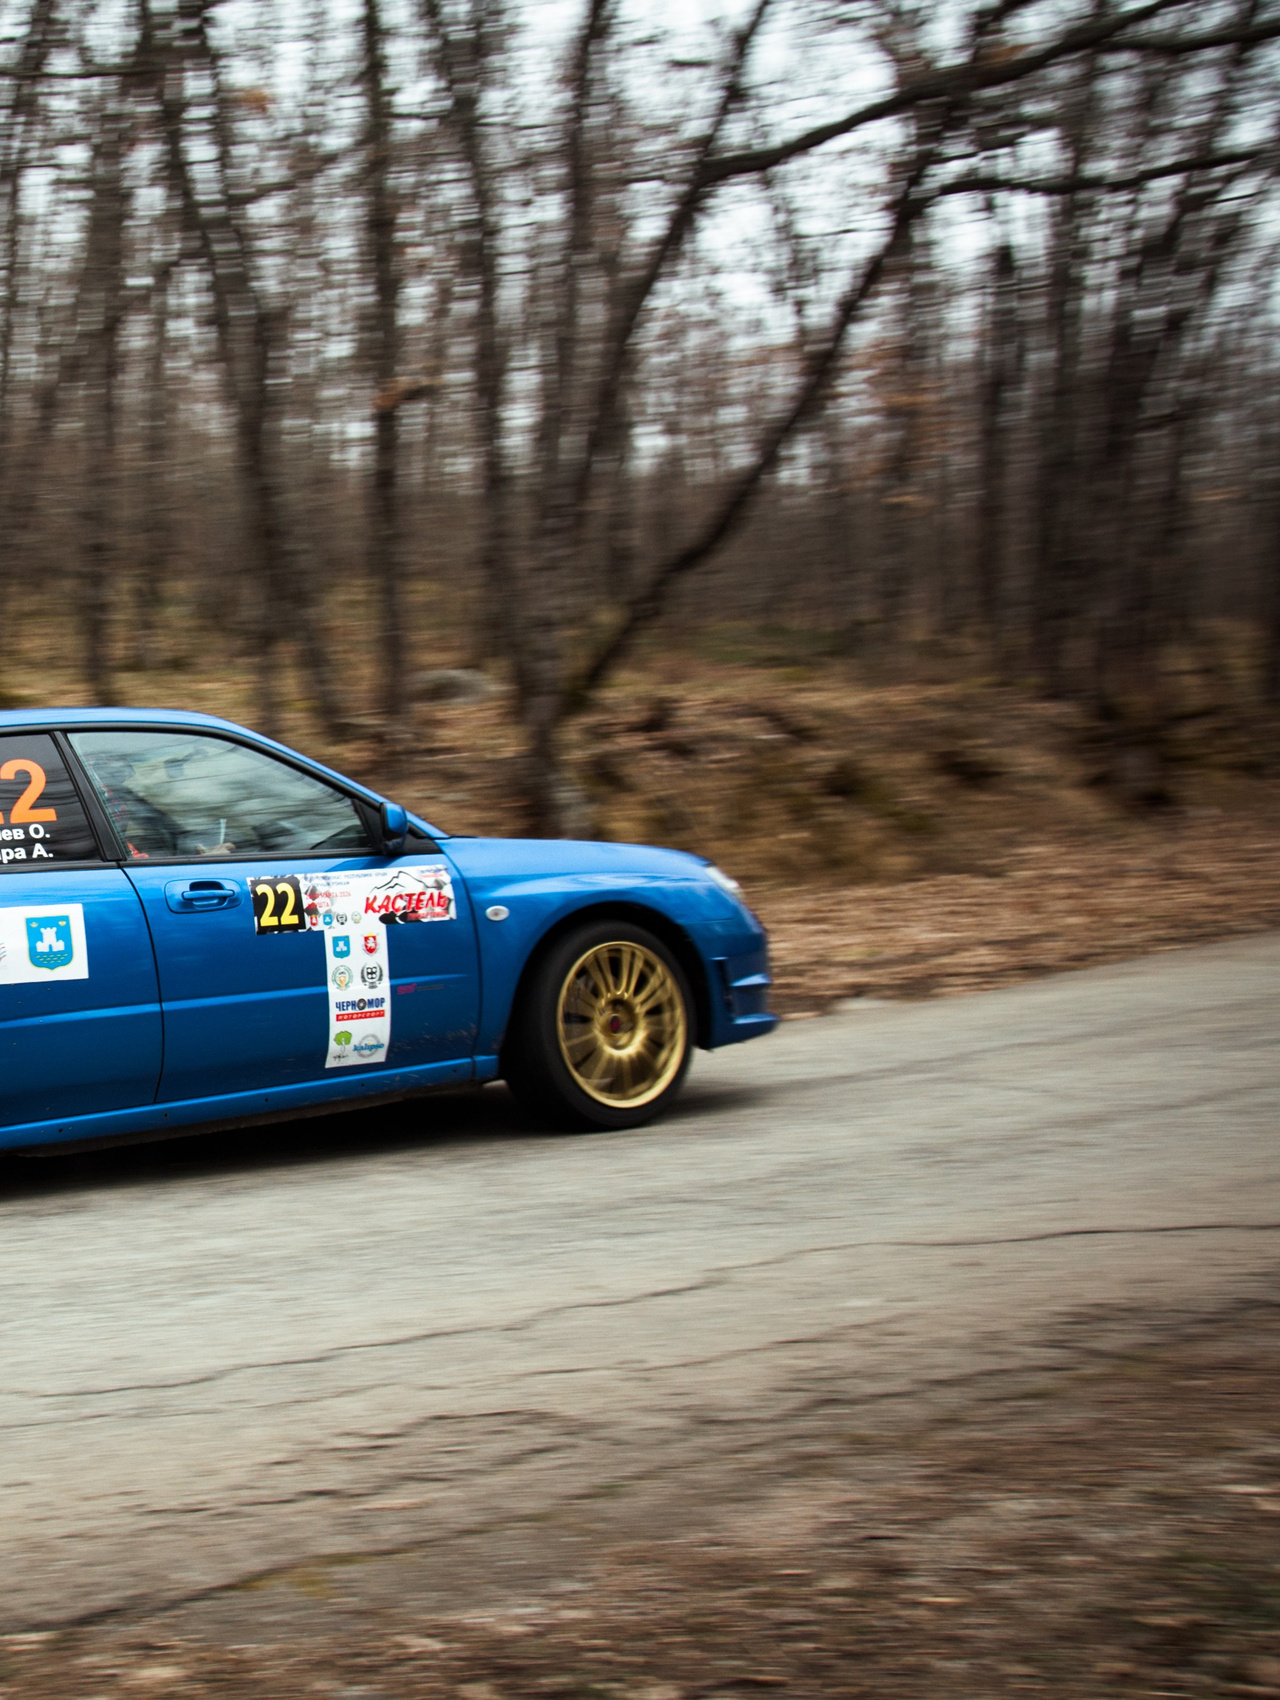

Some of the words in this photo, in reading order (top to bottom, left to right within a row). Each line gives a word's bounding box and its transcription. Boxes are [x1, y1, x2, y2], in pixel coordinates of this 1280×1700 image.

[28, 823, 51, 839] О.
[32, 843, 54, 858] А.
[255, 882, 300, 927] 22
[364, 890, 449, 914] КАСТЕЛЬ
[335, 998, 385, 1012] ЧЕРНОМОР
[337, 1011, 384, 1021] МОТОРСПОРТ
